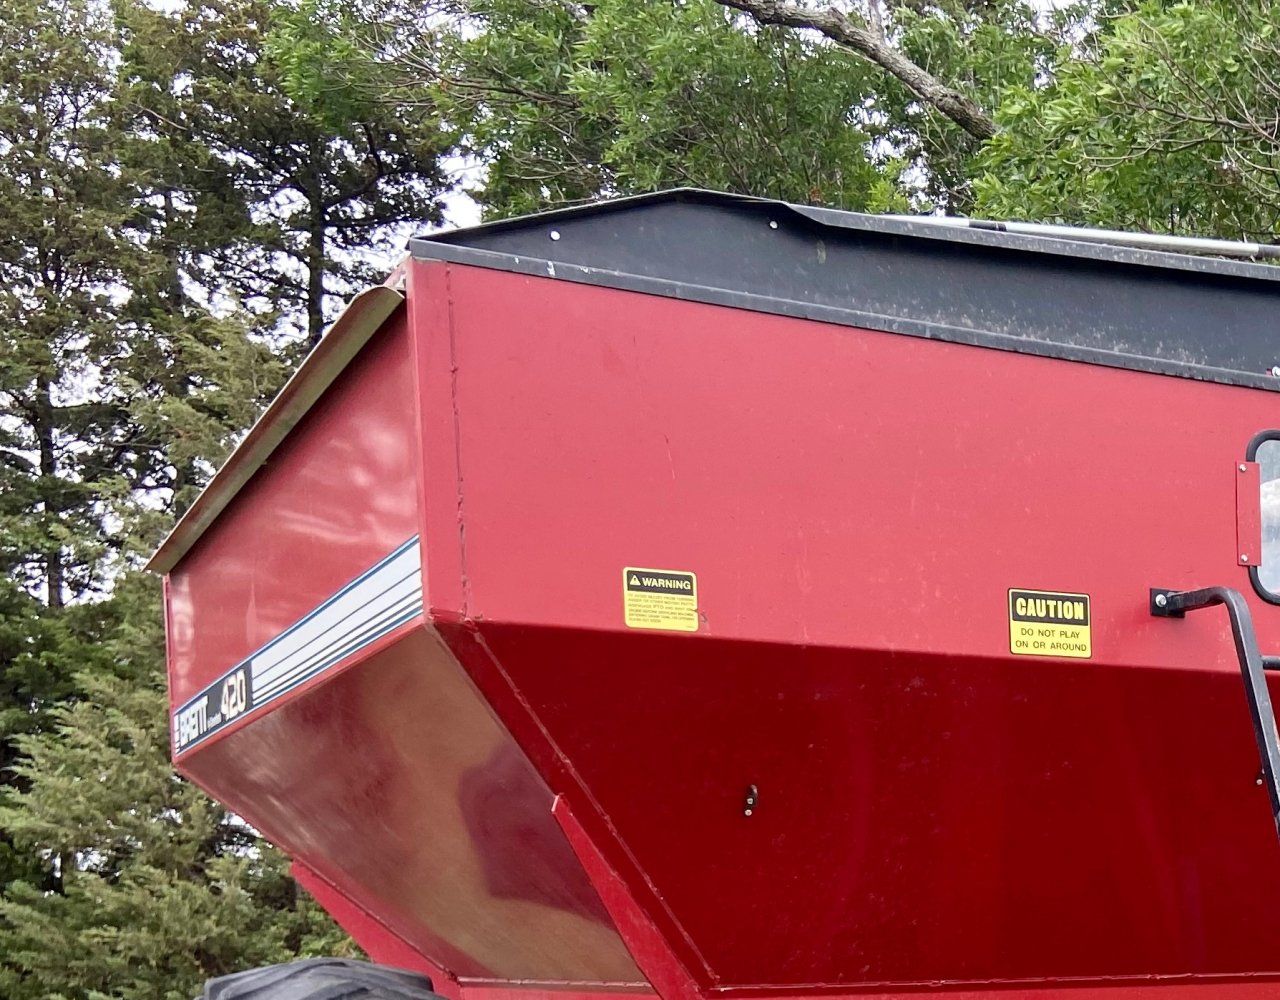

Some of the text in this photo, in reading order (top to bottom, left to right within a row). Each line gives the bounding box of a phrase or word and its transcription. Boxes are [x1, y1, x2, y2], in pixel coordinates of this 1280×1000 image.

[642, 577, 691, 590] WARNING
[1016, 597, 1084, 620] CAUTION
[1021, 627, 1080, 639] DO NOT PLAY
[1015, 640, 1087, 652] ON OR AROUND
[221, 668, 246, 722] 420
